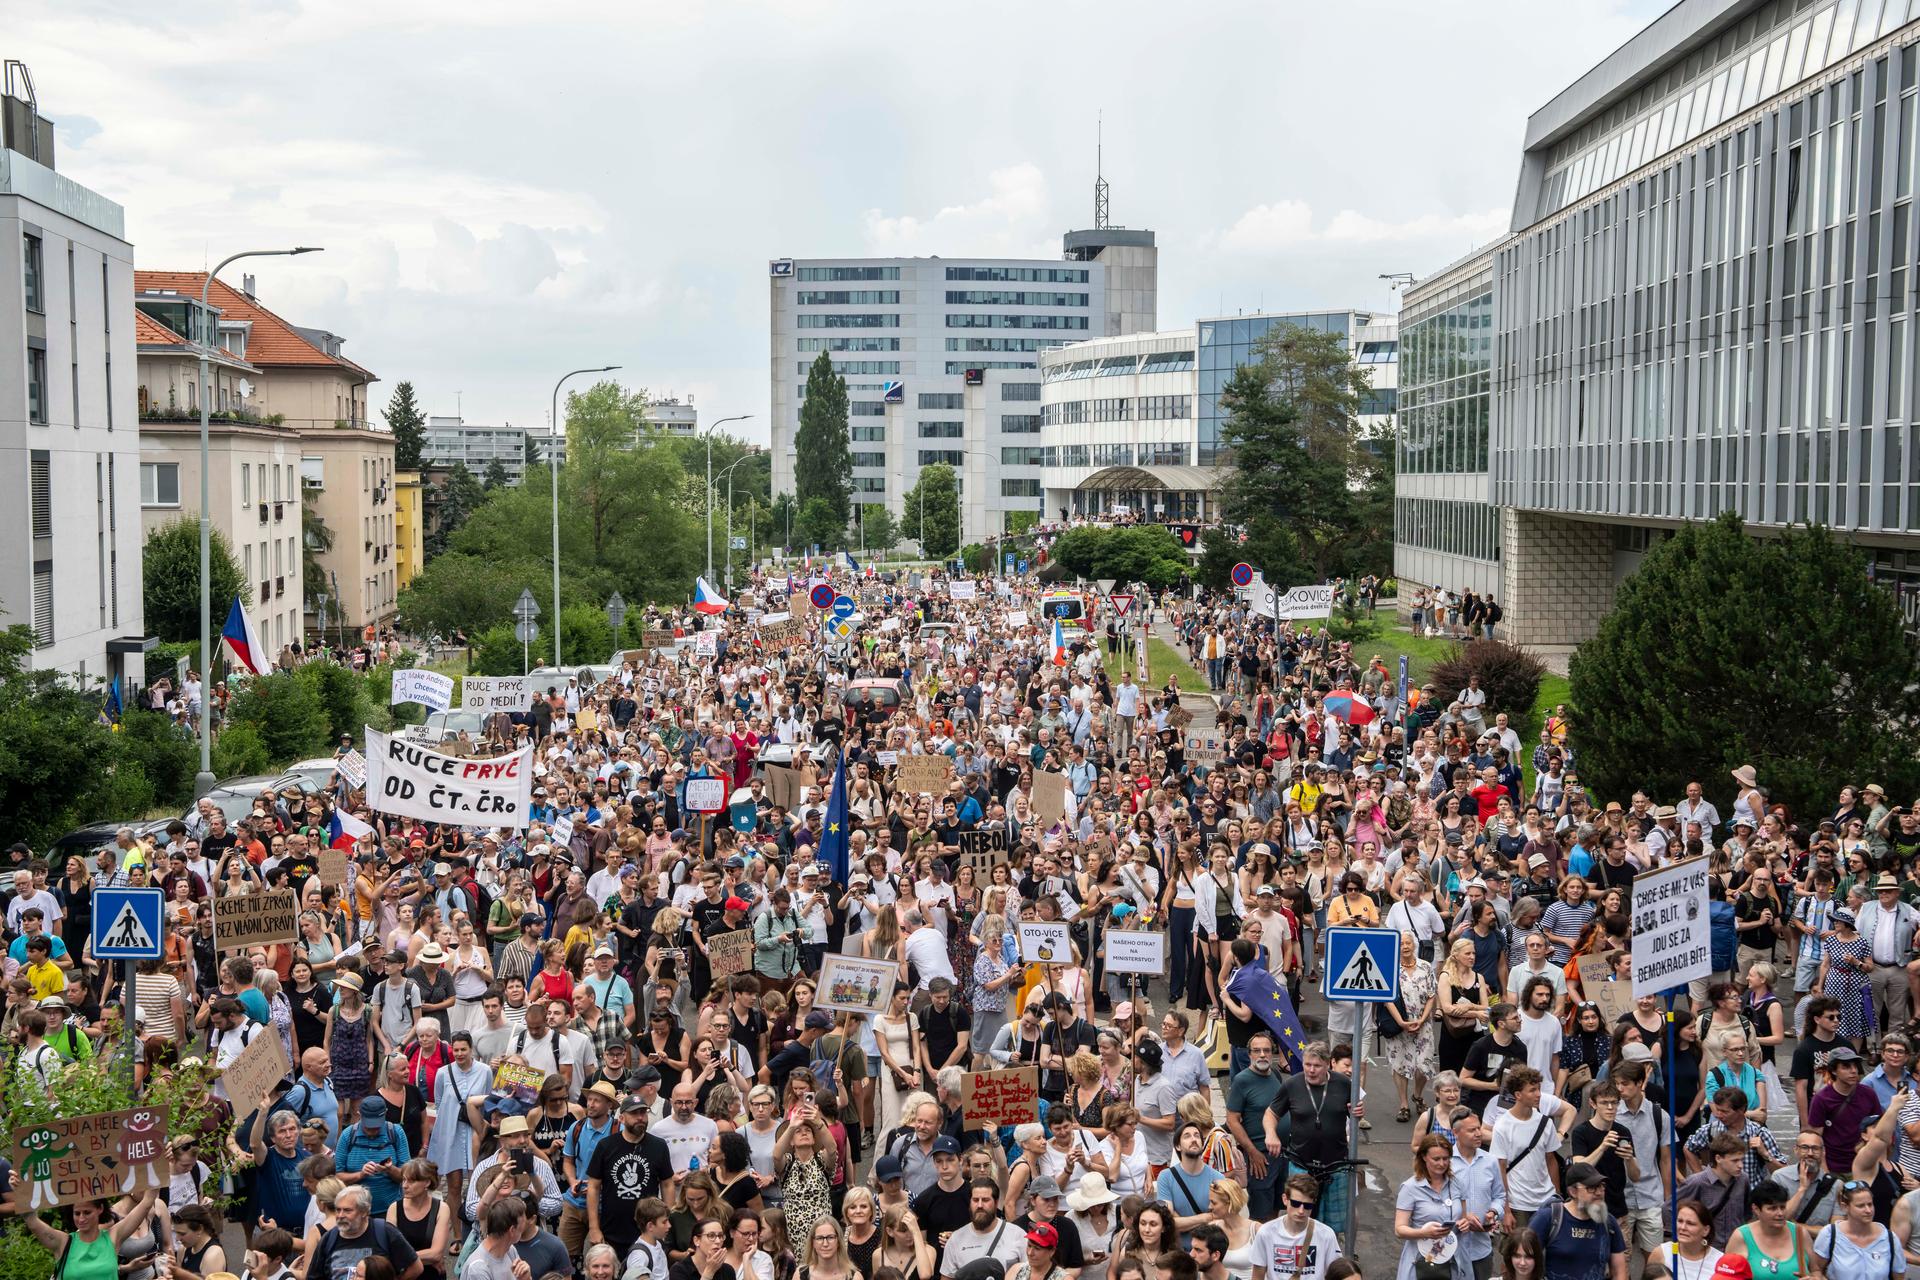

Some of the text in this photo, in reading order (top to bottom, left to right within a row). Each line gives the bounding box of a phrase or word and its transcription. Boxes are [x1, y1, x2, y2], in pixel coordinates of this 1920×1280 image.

[771, 262, 791, 274] ICZ
[408, 671, 425, 680] Make
[466, 679, 523, 692] RUCE PRYČ
[469, 696, 485, 707] OD
[389, 739, 458, 776] RUCE
[463, 756, 520, 779] PRYČ
[385, 775, 516, 814] OD ČT a ČRo
[688, 800, 699, 809] NE
[959, 830, 1007, 854] NEBOJ
[1084, 842, 1099, 851] OTO
[1636, 871, 1706, 909] CHCE SE MI Z VÁS
[248, 895, 261, 912] MÍT
[263, 891, 294, 911] ZPRÁVY
[1660, 902, 1680, 925] BLÍT,
[216, 910, 296, 938] BEZ VLÁDNÍ SPRÁVY
[1024, 927, 1064, 938] OTO-VÍCE
[1112, 939, 1136, 947] NAŠEHO
[1651, 927, 1691, 954] JDU SE ZA
[1638, 946, 1707, 984] DEMOKRACII BÍT!
[231, 1070, 243, 1086] CO
[81, 1120, 92, 1135] A
[94, 1116, 120, 1131] HELE
[90, 1133, 110, 1151] BY
[127, 1140, 156, 1161] HELE
[84, 1157, 95, 1170] S
[80, 1171, 120, 1198] NÁMI
